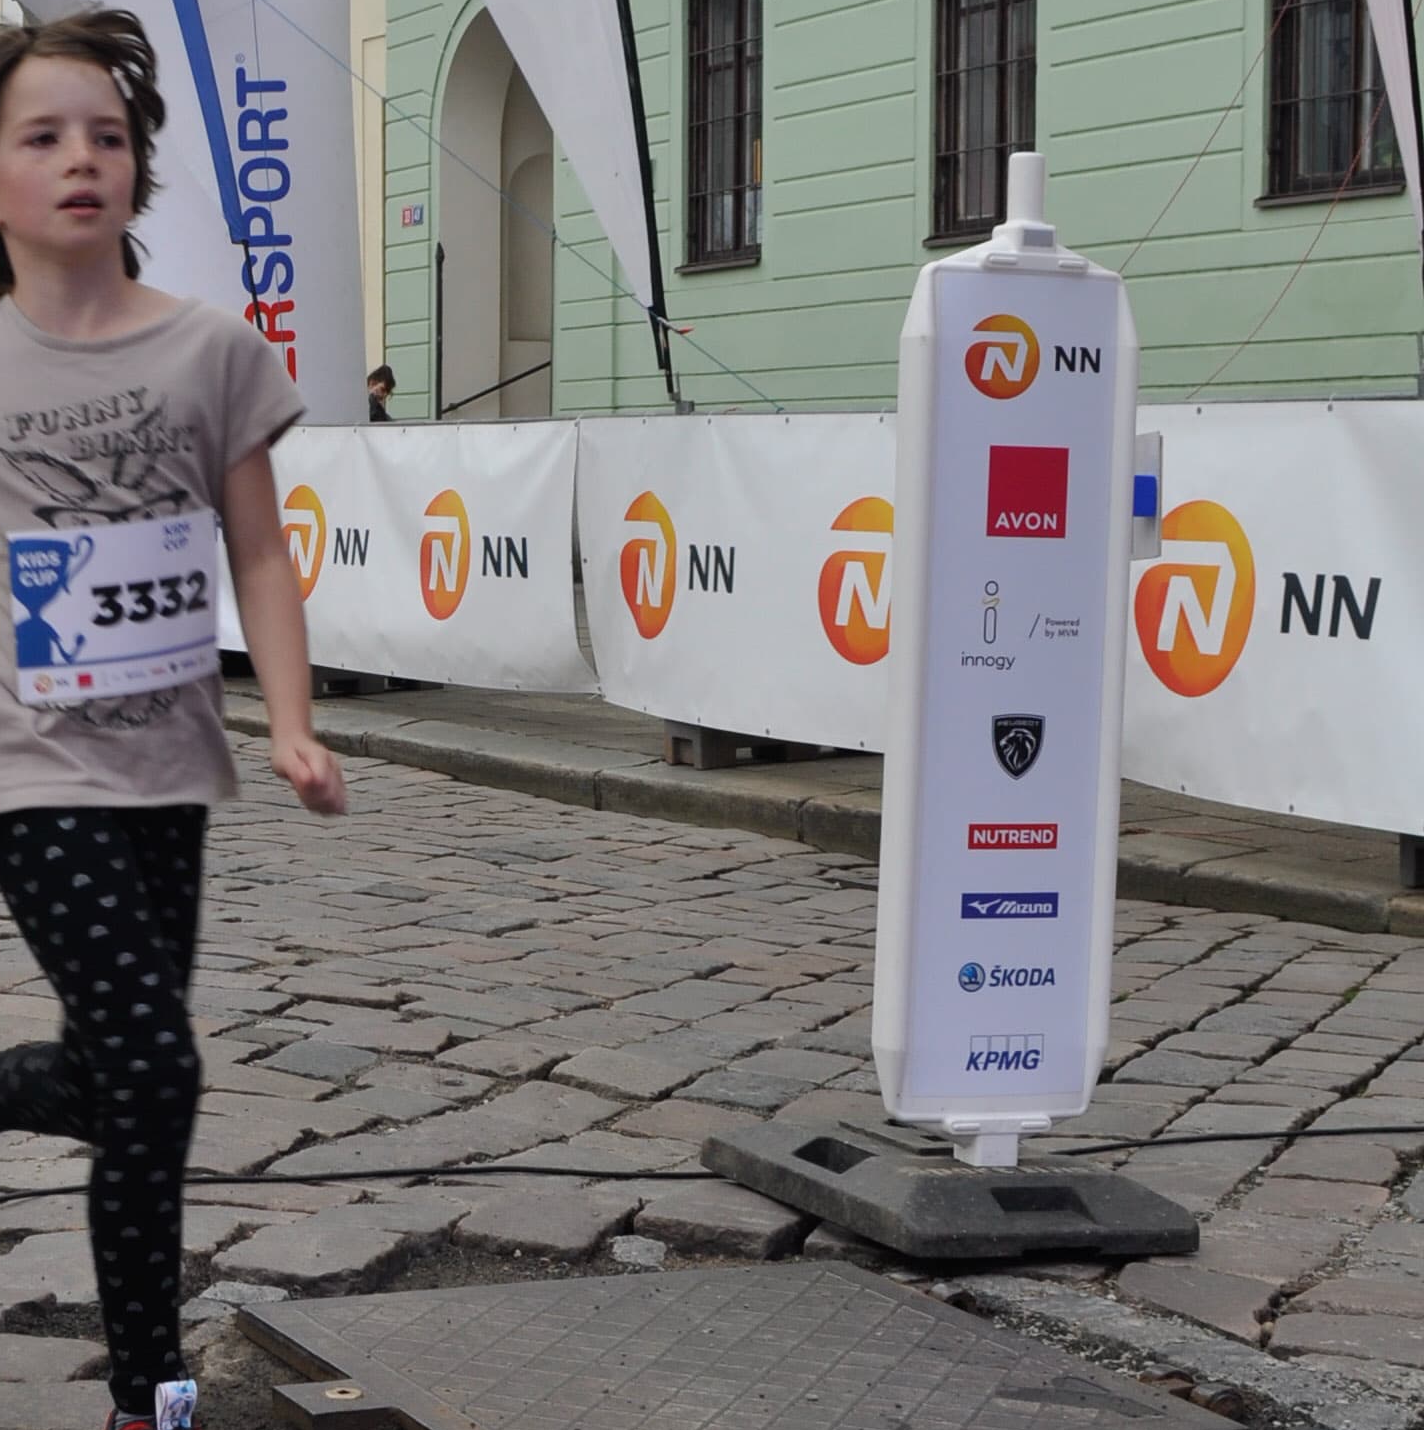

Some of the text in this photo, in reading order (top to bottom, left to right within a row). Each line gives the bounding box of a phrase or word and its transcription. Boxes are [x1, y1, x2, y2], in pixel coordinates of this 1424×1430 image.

[1054, 345, 1101, 373] NN
[995, 512, 1057, 531] AVON
[333, 527, 370, 567] NN
[482, 536, 529, 579] NN
[16, 550, 61, 569] KIDS
[689, 544, 737, 595] NN
[18, 569, 59, 587] CUP
[91, 570, 207, 627] 3332
[1280, 572, 1383, 642] NN
[961, 651, 1016, 670] innogy
[973, 829, 1053, 844] NUTREND
[989, 965, 1056, 987] ŠKODA
[966, 1050, 1041, 1071] KPMG
